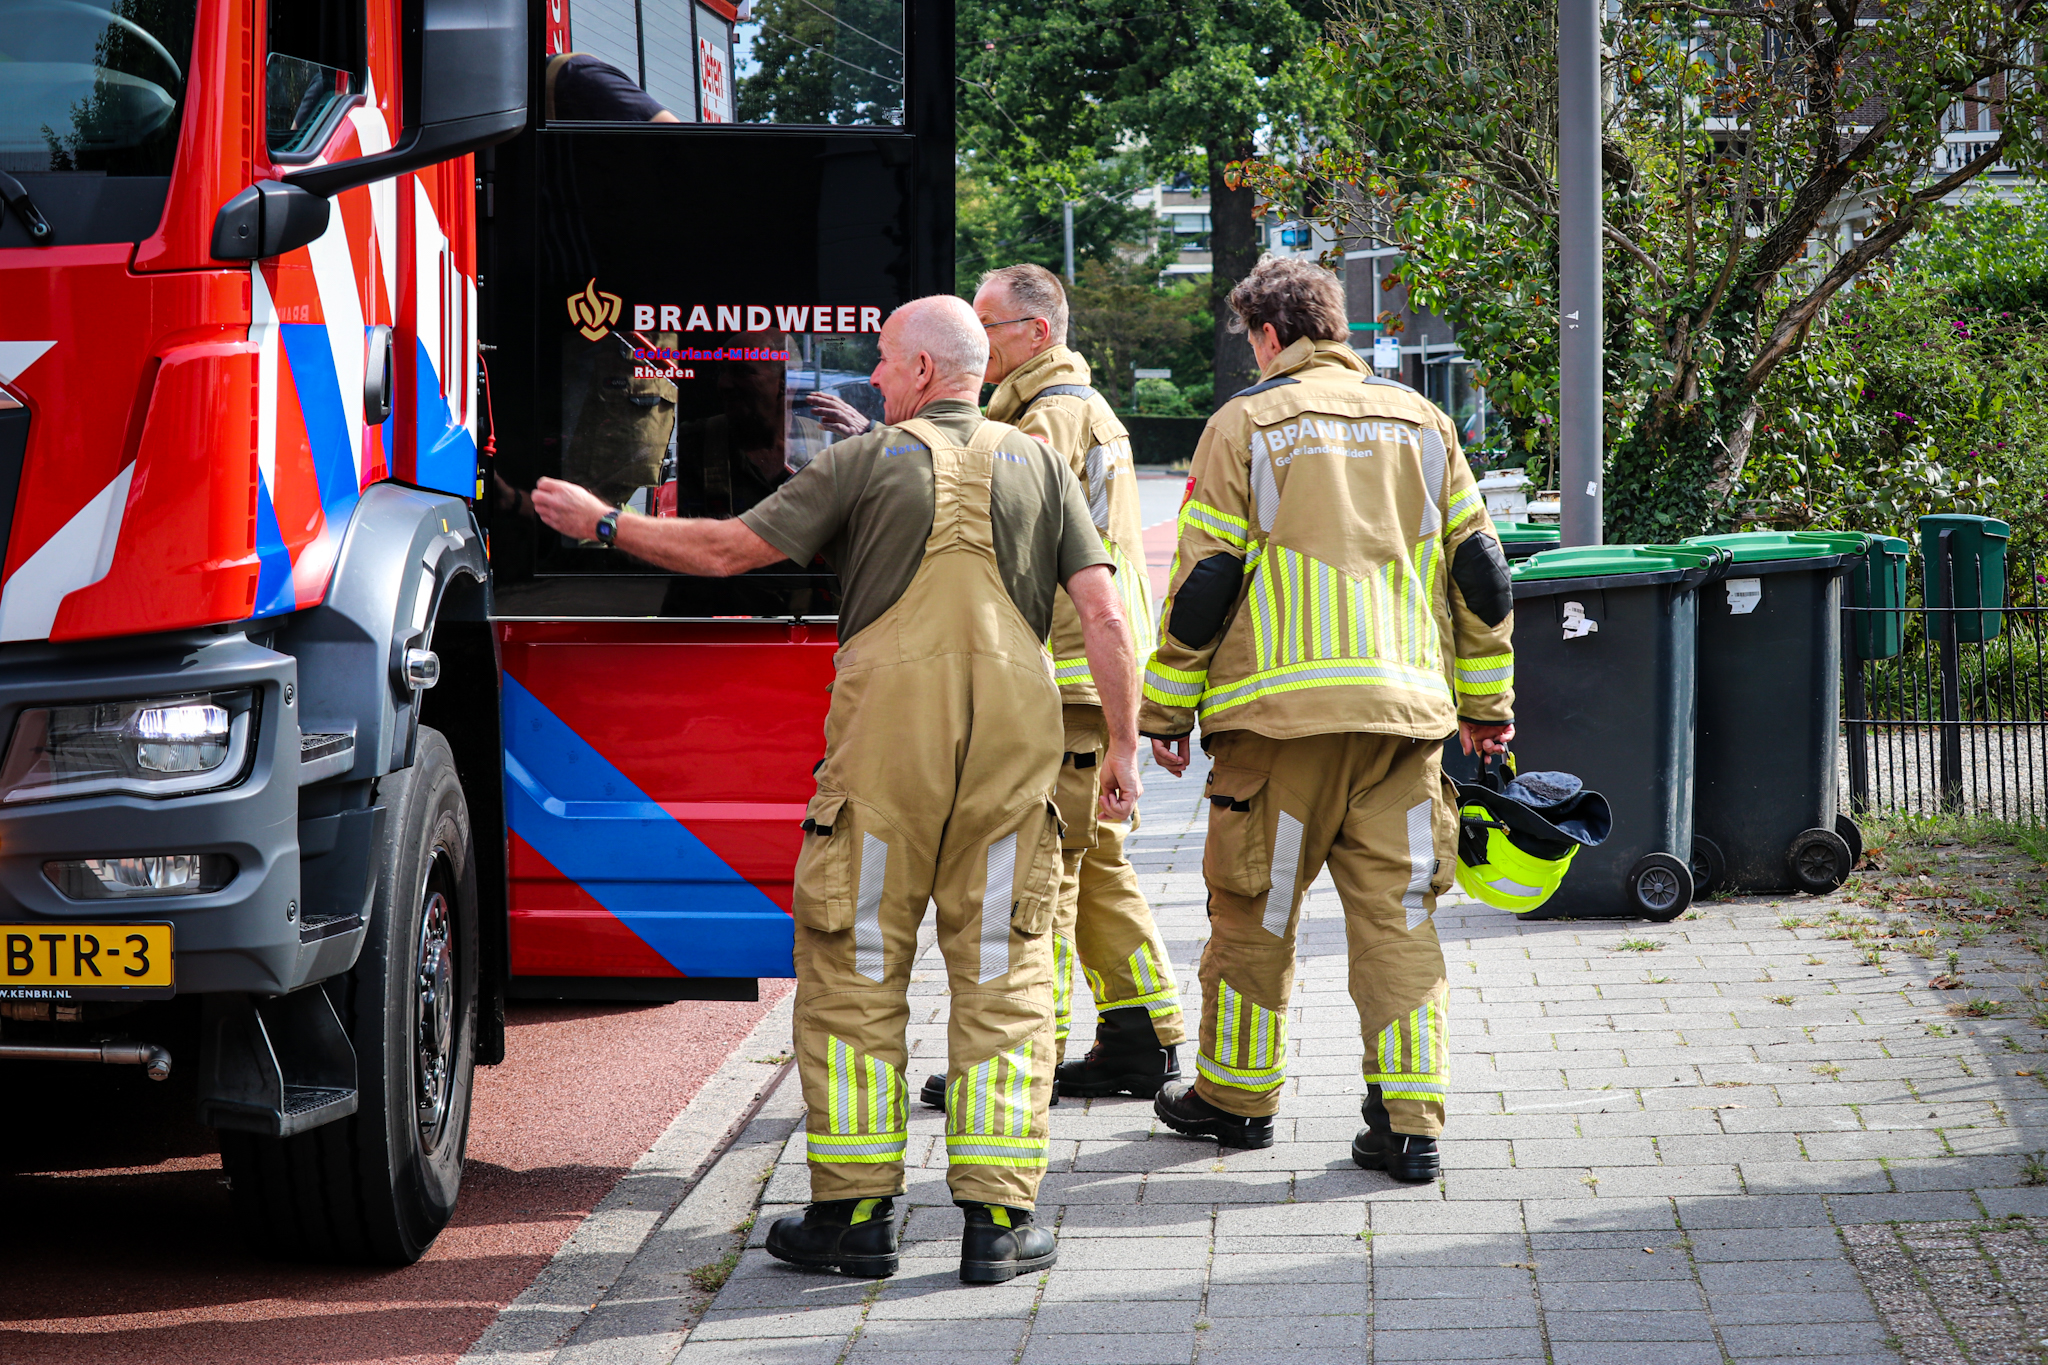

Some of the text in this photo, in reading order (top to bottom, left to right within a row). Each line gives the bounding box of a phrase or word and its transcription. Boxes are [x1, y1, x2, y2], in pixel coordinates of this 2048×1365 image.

[634, 305, 882, 333] BRANDWEER
[634, 347, 790, 361] Gelderland-Midden
[634, 366, 695, 379] Rheden
[1265, 418, 1421, 450] BRANDWEER
[1274, 445, 1373, 467] Gelerland-Midden
[6, 933, 151, 977] BTR-3
